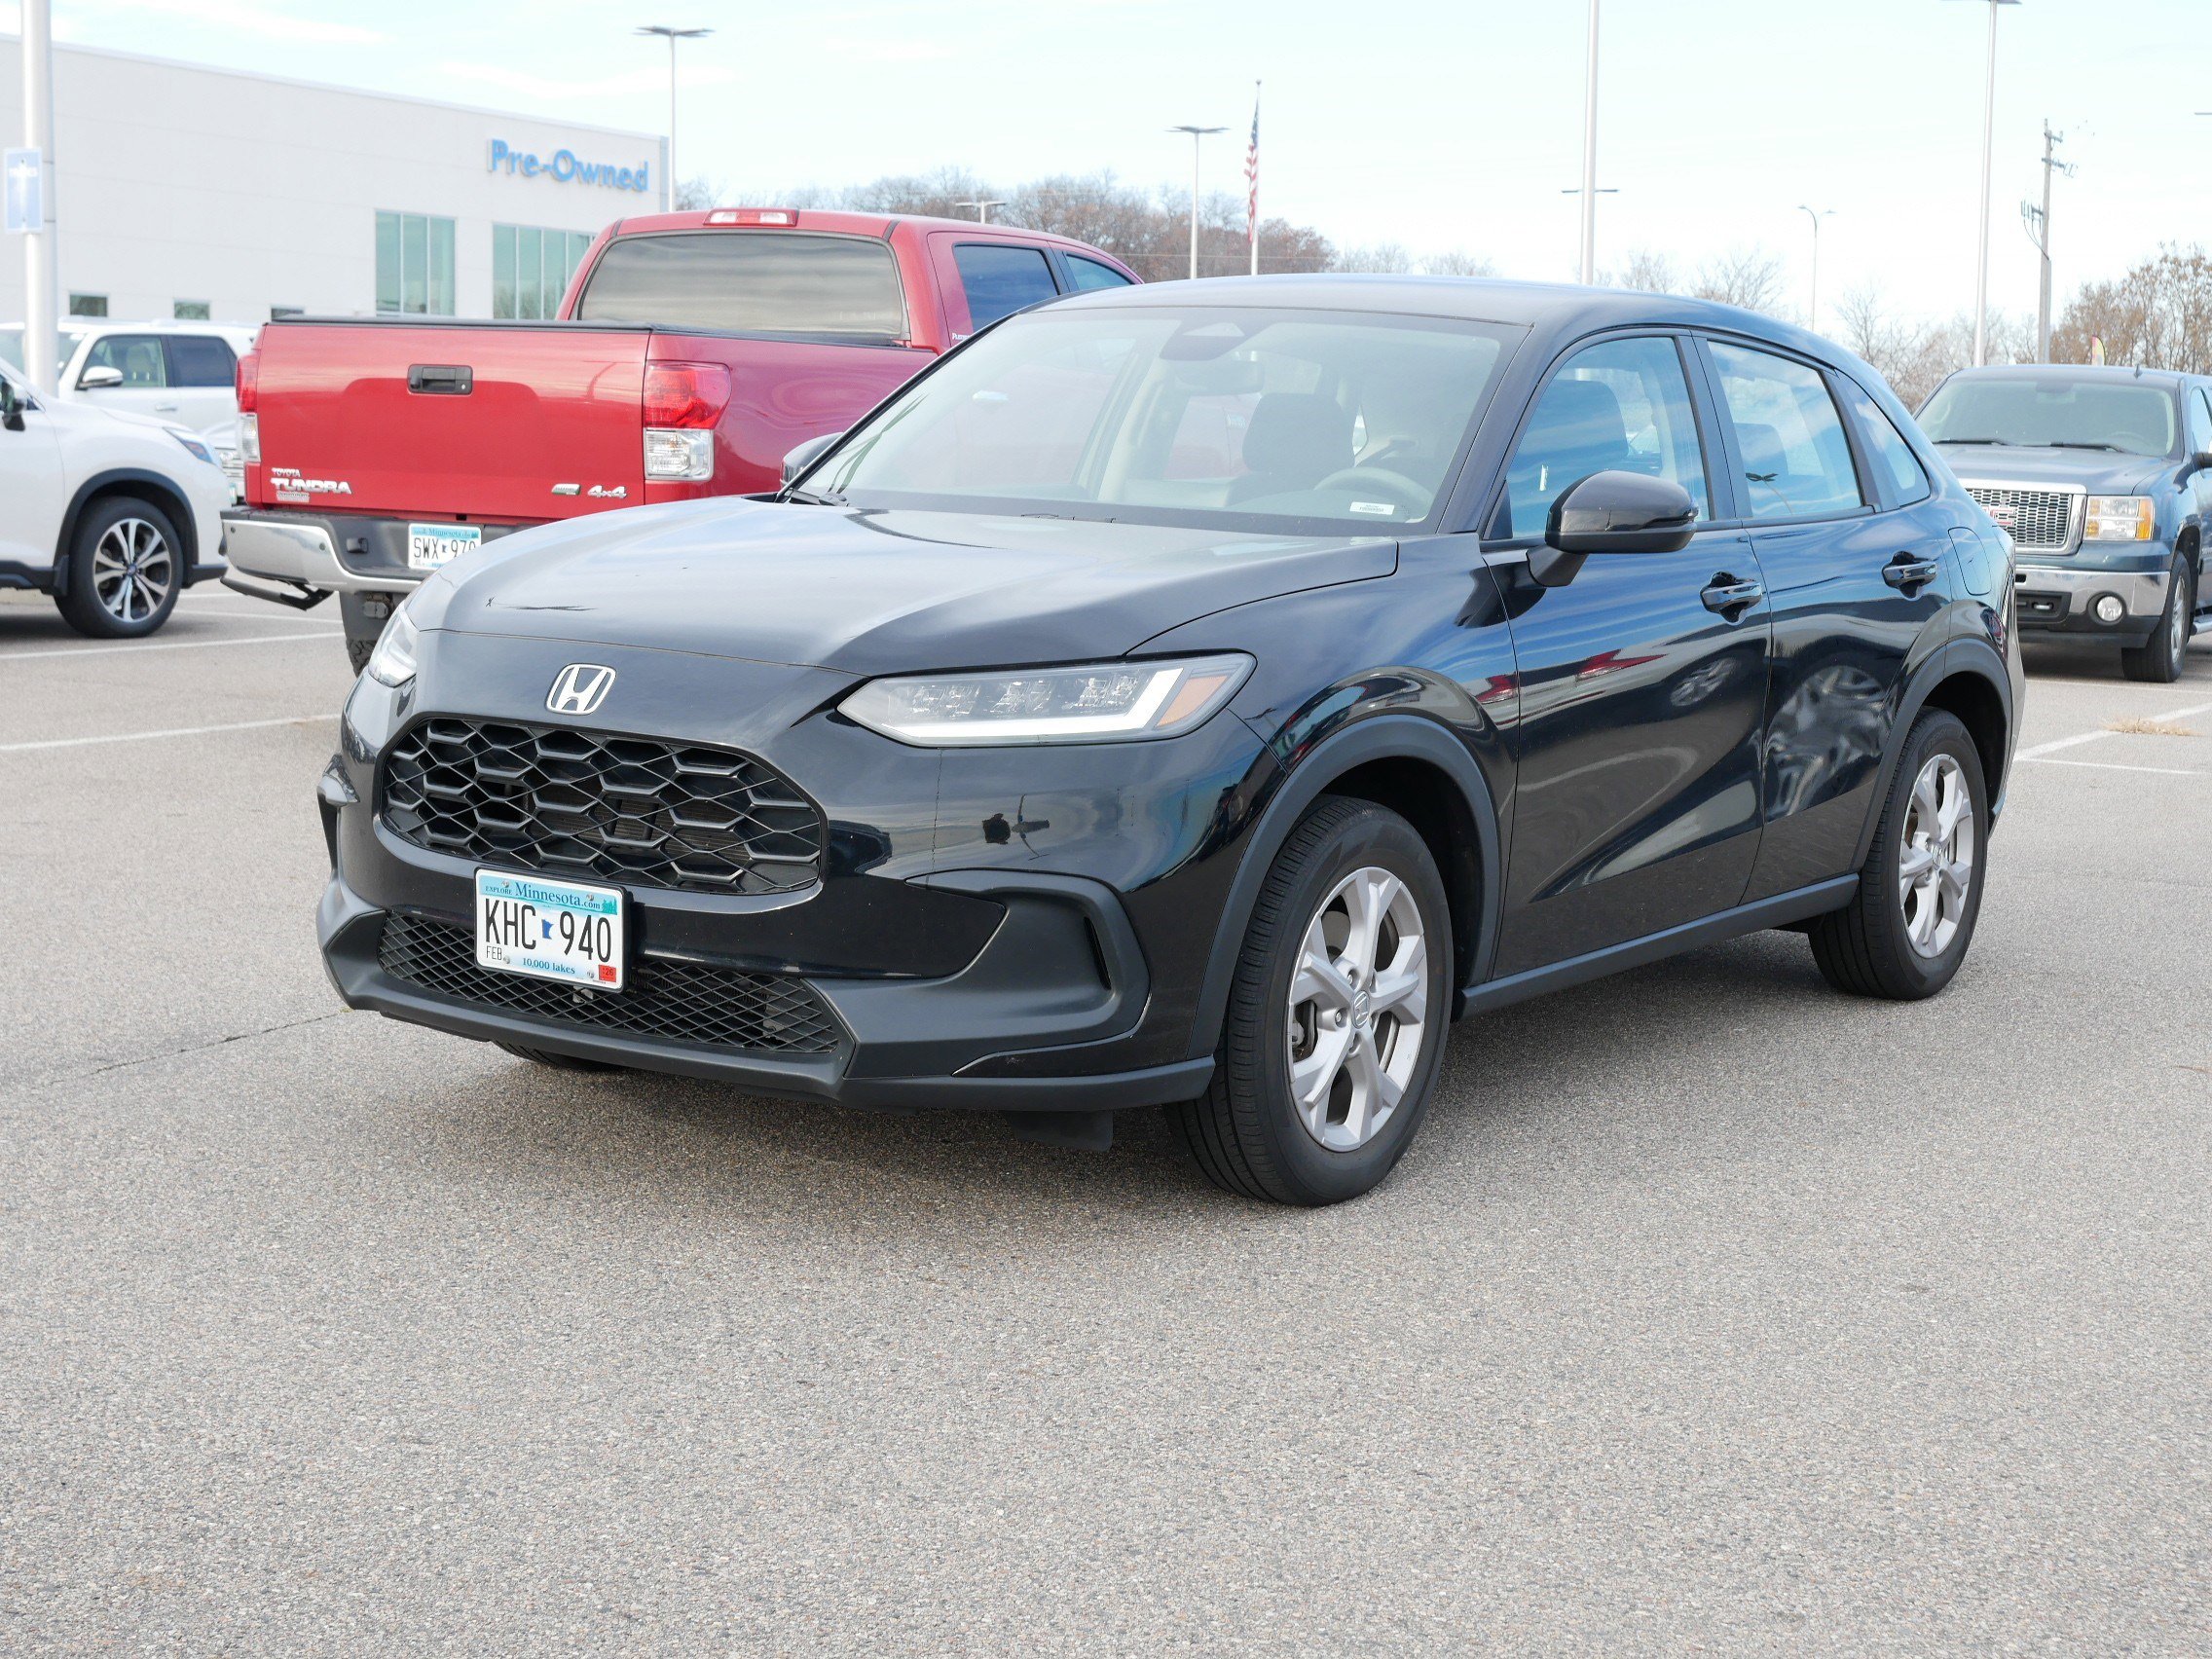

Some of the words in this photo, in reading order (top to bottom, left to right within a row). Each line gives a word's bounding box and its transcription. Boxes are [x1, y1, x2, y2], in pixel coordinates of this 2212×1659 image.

[488, 139, 649, 192] Pre-Owned
[271, 468, 301, 477] TOYOTA
[270, 477, 352, 495] TUNDRA
[414, 537, 439, 560] SWX
[486, 885, 512, 895] EXPLORE
[514, 882, 601, 910] Minnesota.com
[485, 898, 536, 950] KHC
[559, 910, 612, 963] 940
[486, 945, 502, 961] FEB
[523, 957, 550, 970] 10,000
[552, 962, 575, 975] lakes
